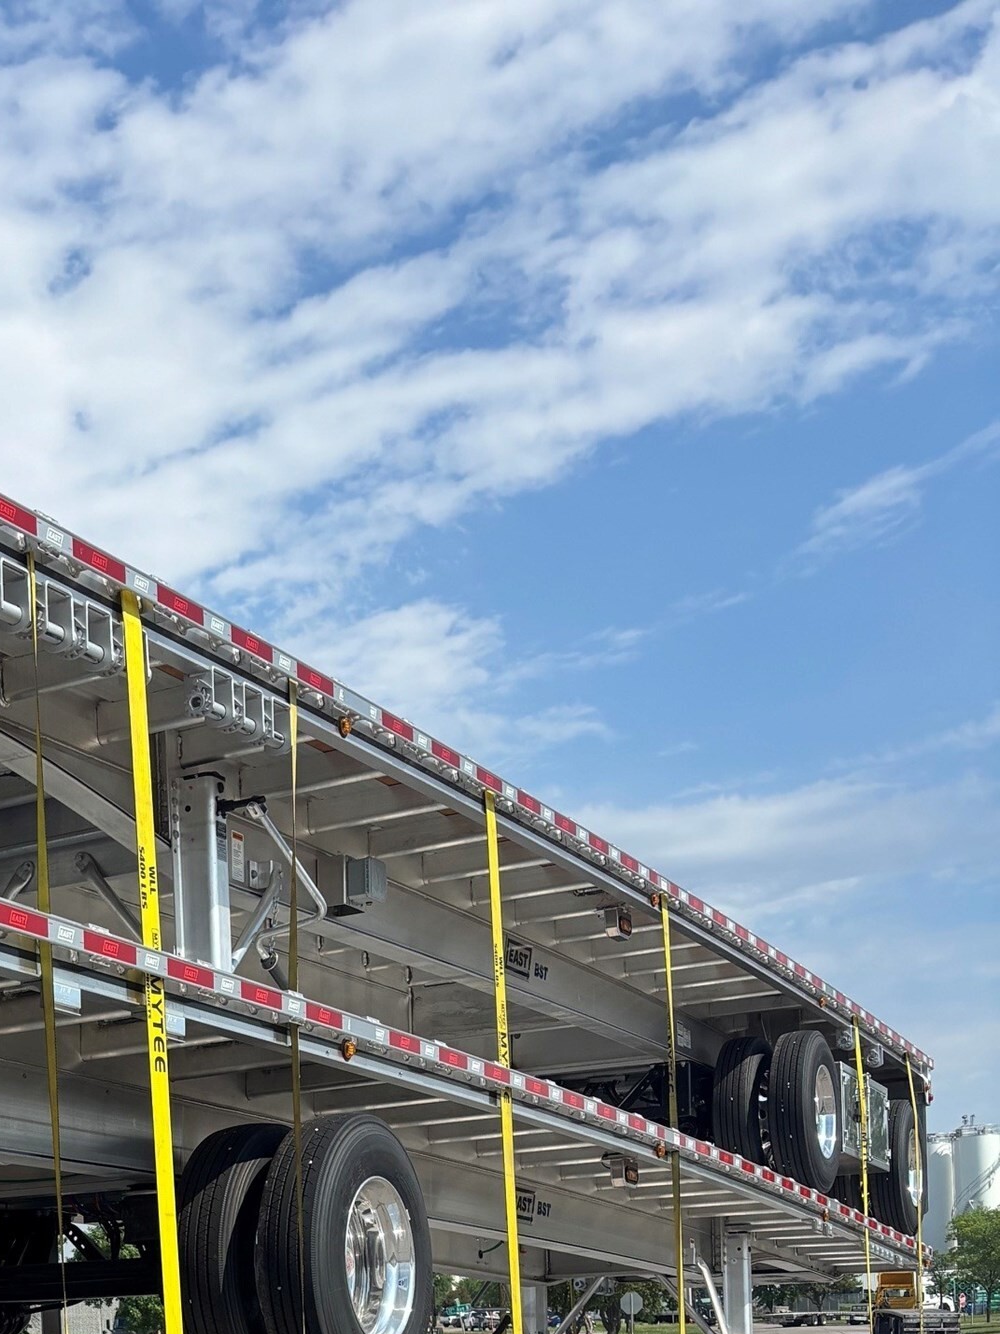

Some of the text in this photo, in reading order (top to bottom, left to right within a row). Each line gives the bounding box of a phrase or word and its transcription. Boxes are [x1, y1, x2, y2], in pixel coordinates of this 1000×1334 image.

[11, 913, 27, 926] EAST
[508, 948, 549, 980] EAST BST
[537, 1200, 551, 1217] BST
